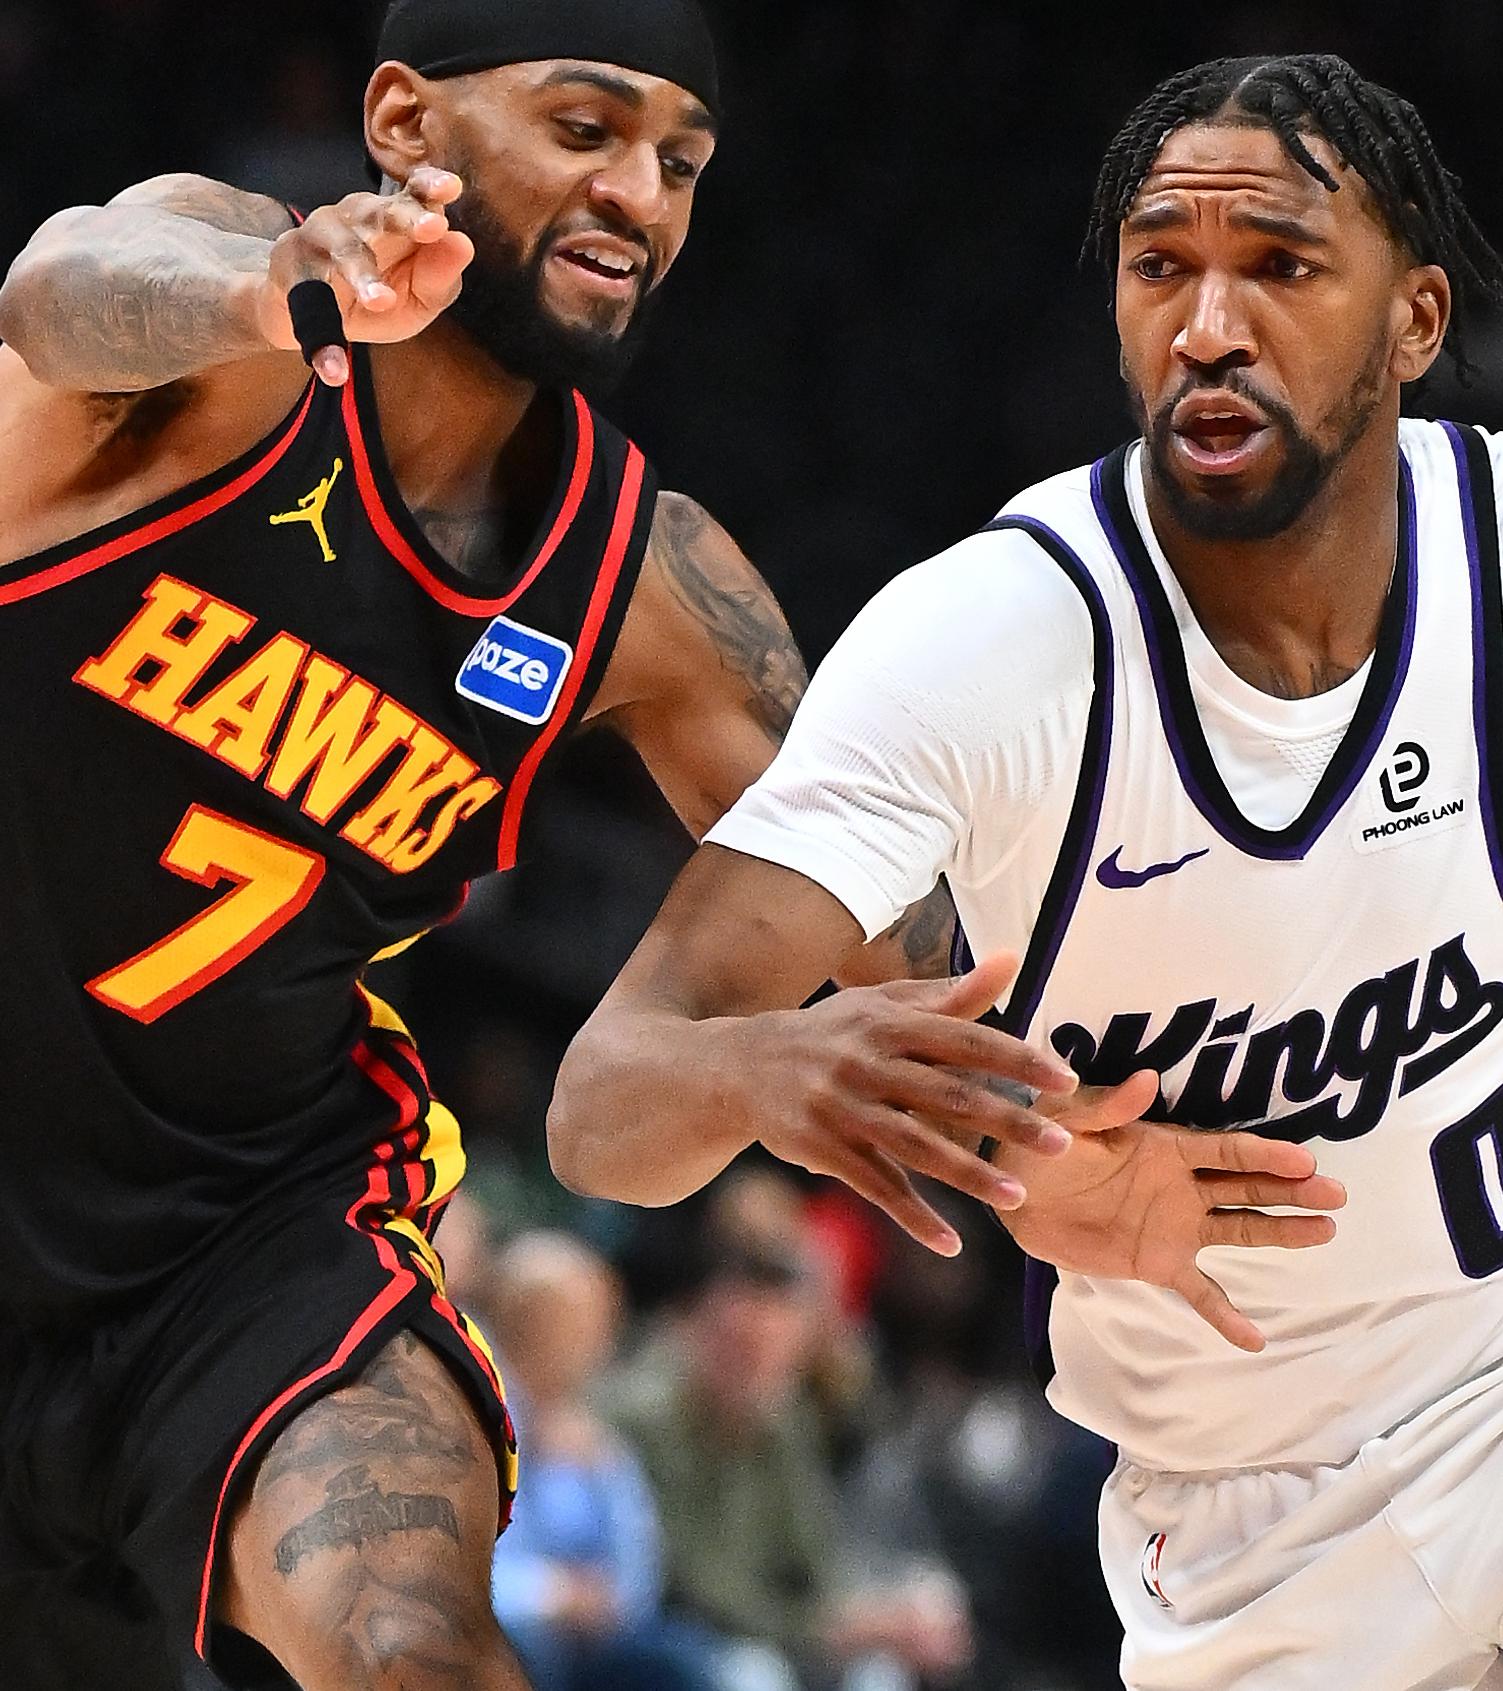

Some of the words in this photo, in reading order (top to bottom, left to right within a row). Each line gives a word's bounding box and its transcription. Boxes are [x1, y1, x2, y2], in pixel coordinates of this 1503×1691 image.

[73, 573, 502, 875] HAWKS
[467, 638, 549, 691] paze
[1362, 811, 1431, 842] PHOONG
[1432, 799, 1464, 820] LAW
[83, 802, 326, 1024] 7
